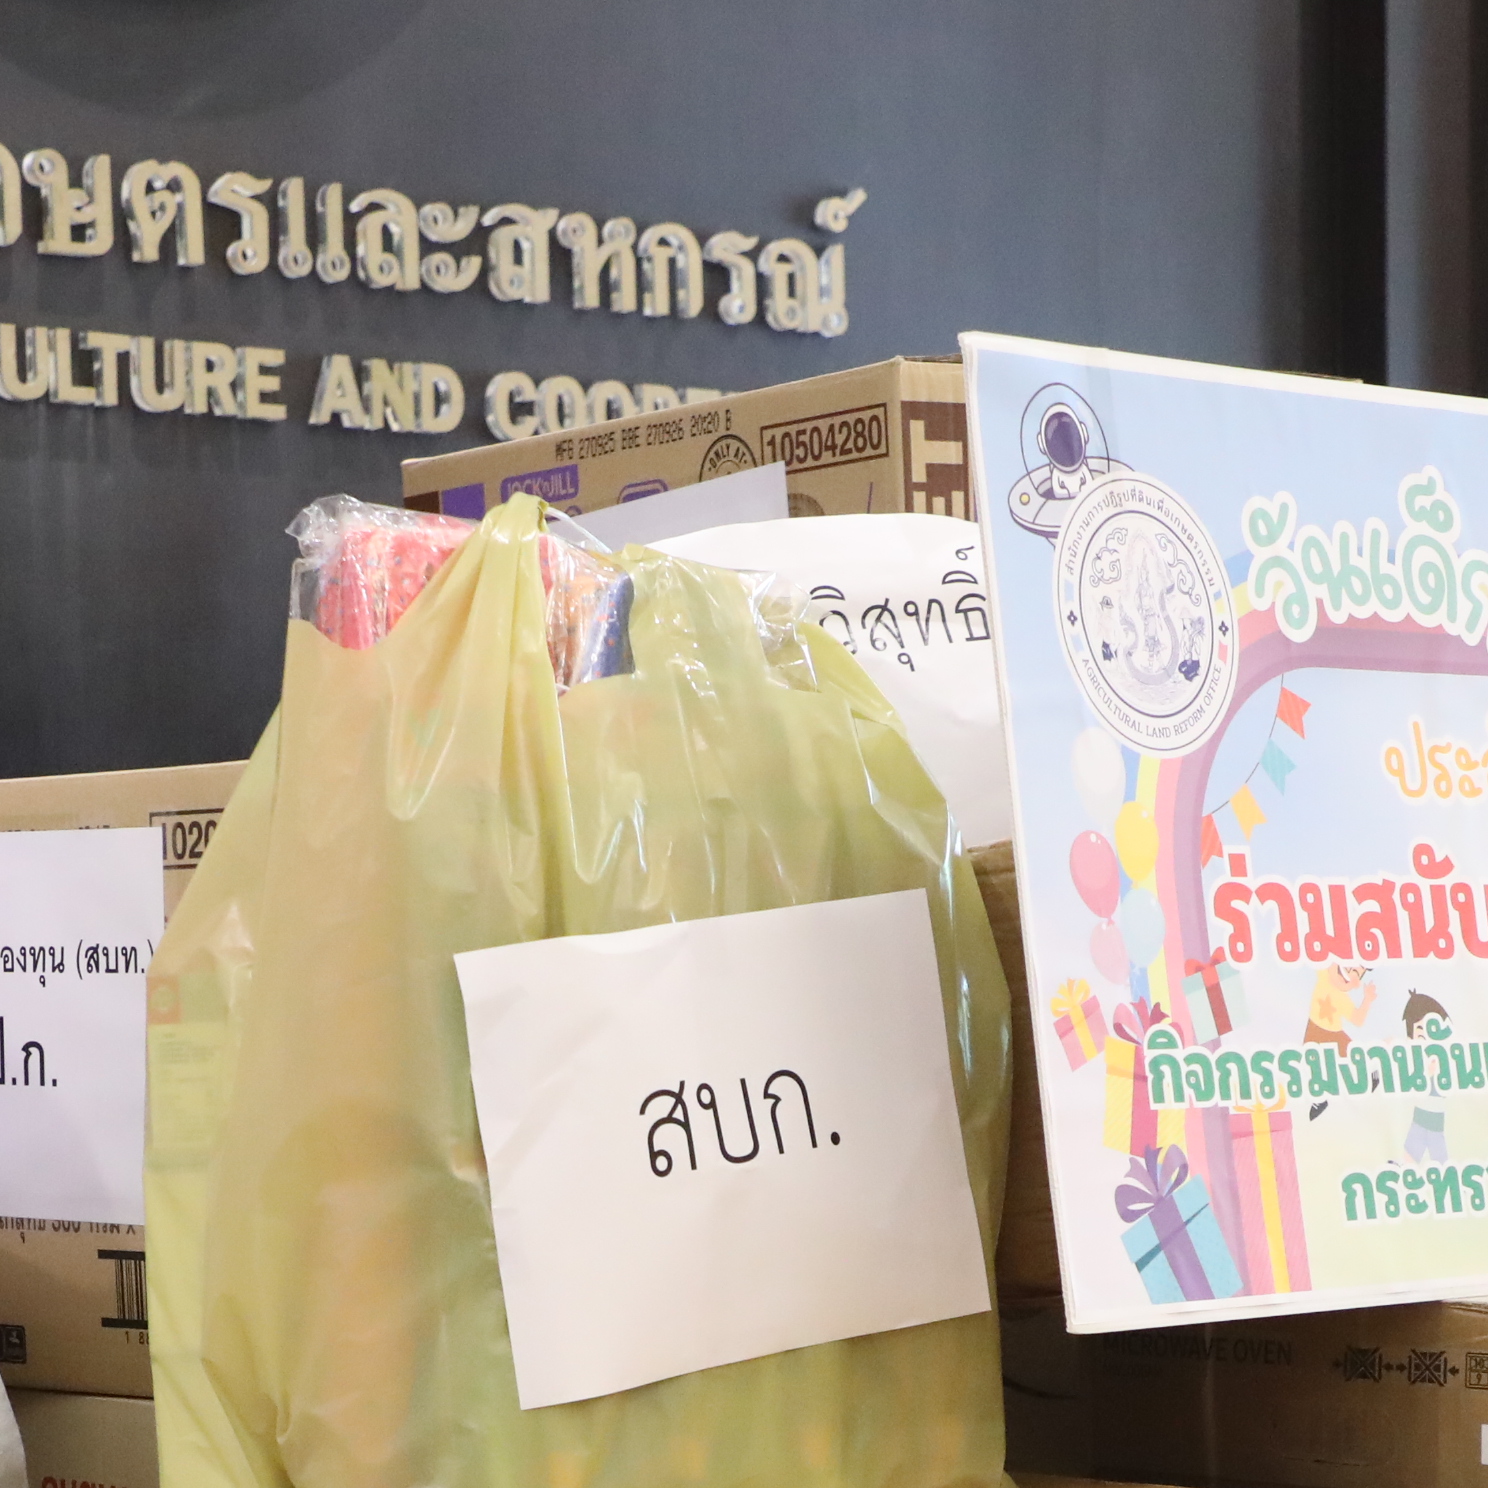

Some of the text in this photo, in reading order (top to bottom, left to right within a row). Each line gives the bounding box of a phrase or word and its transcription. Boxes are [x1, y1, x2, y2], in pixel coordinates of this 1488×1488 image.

[310, 353, 463, 433] AND
[708, 440, 732, 470] ONLY
[765, 413, 884, 468] 10504280
[1081, 658, 1223, 739] AGRICULTURAL LAND REFORM OFFICE
[638, 1069, 841, 1179] สบก.
[1232, 1337, 1293, 1366] OVEN
